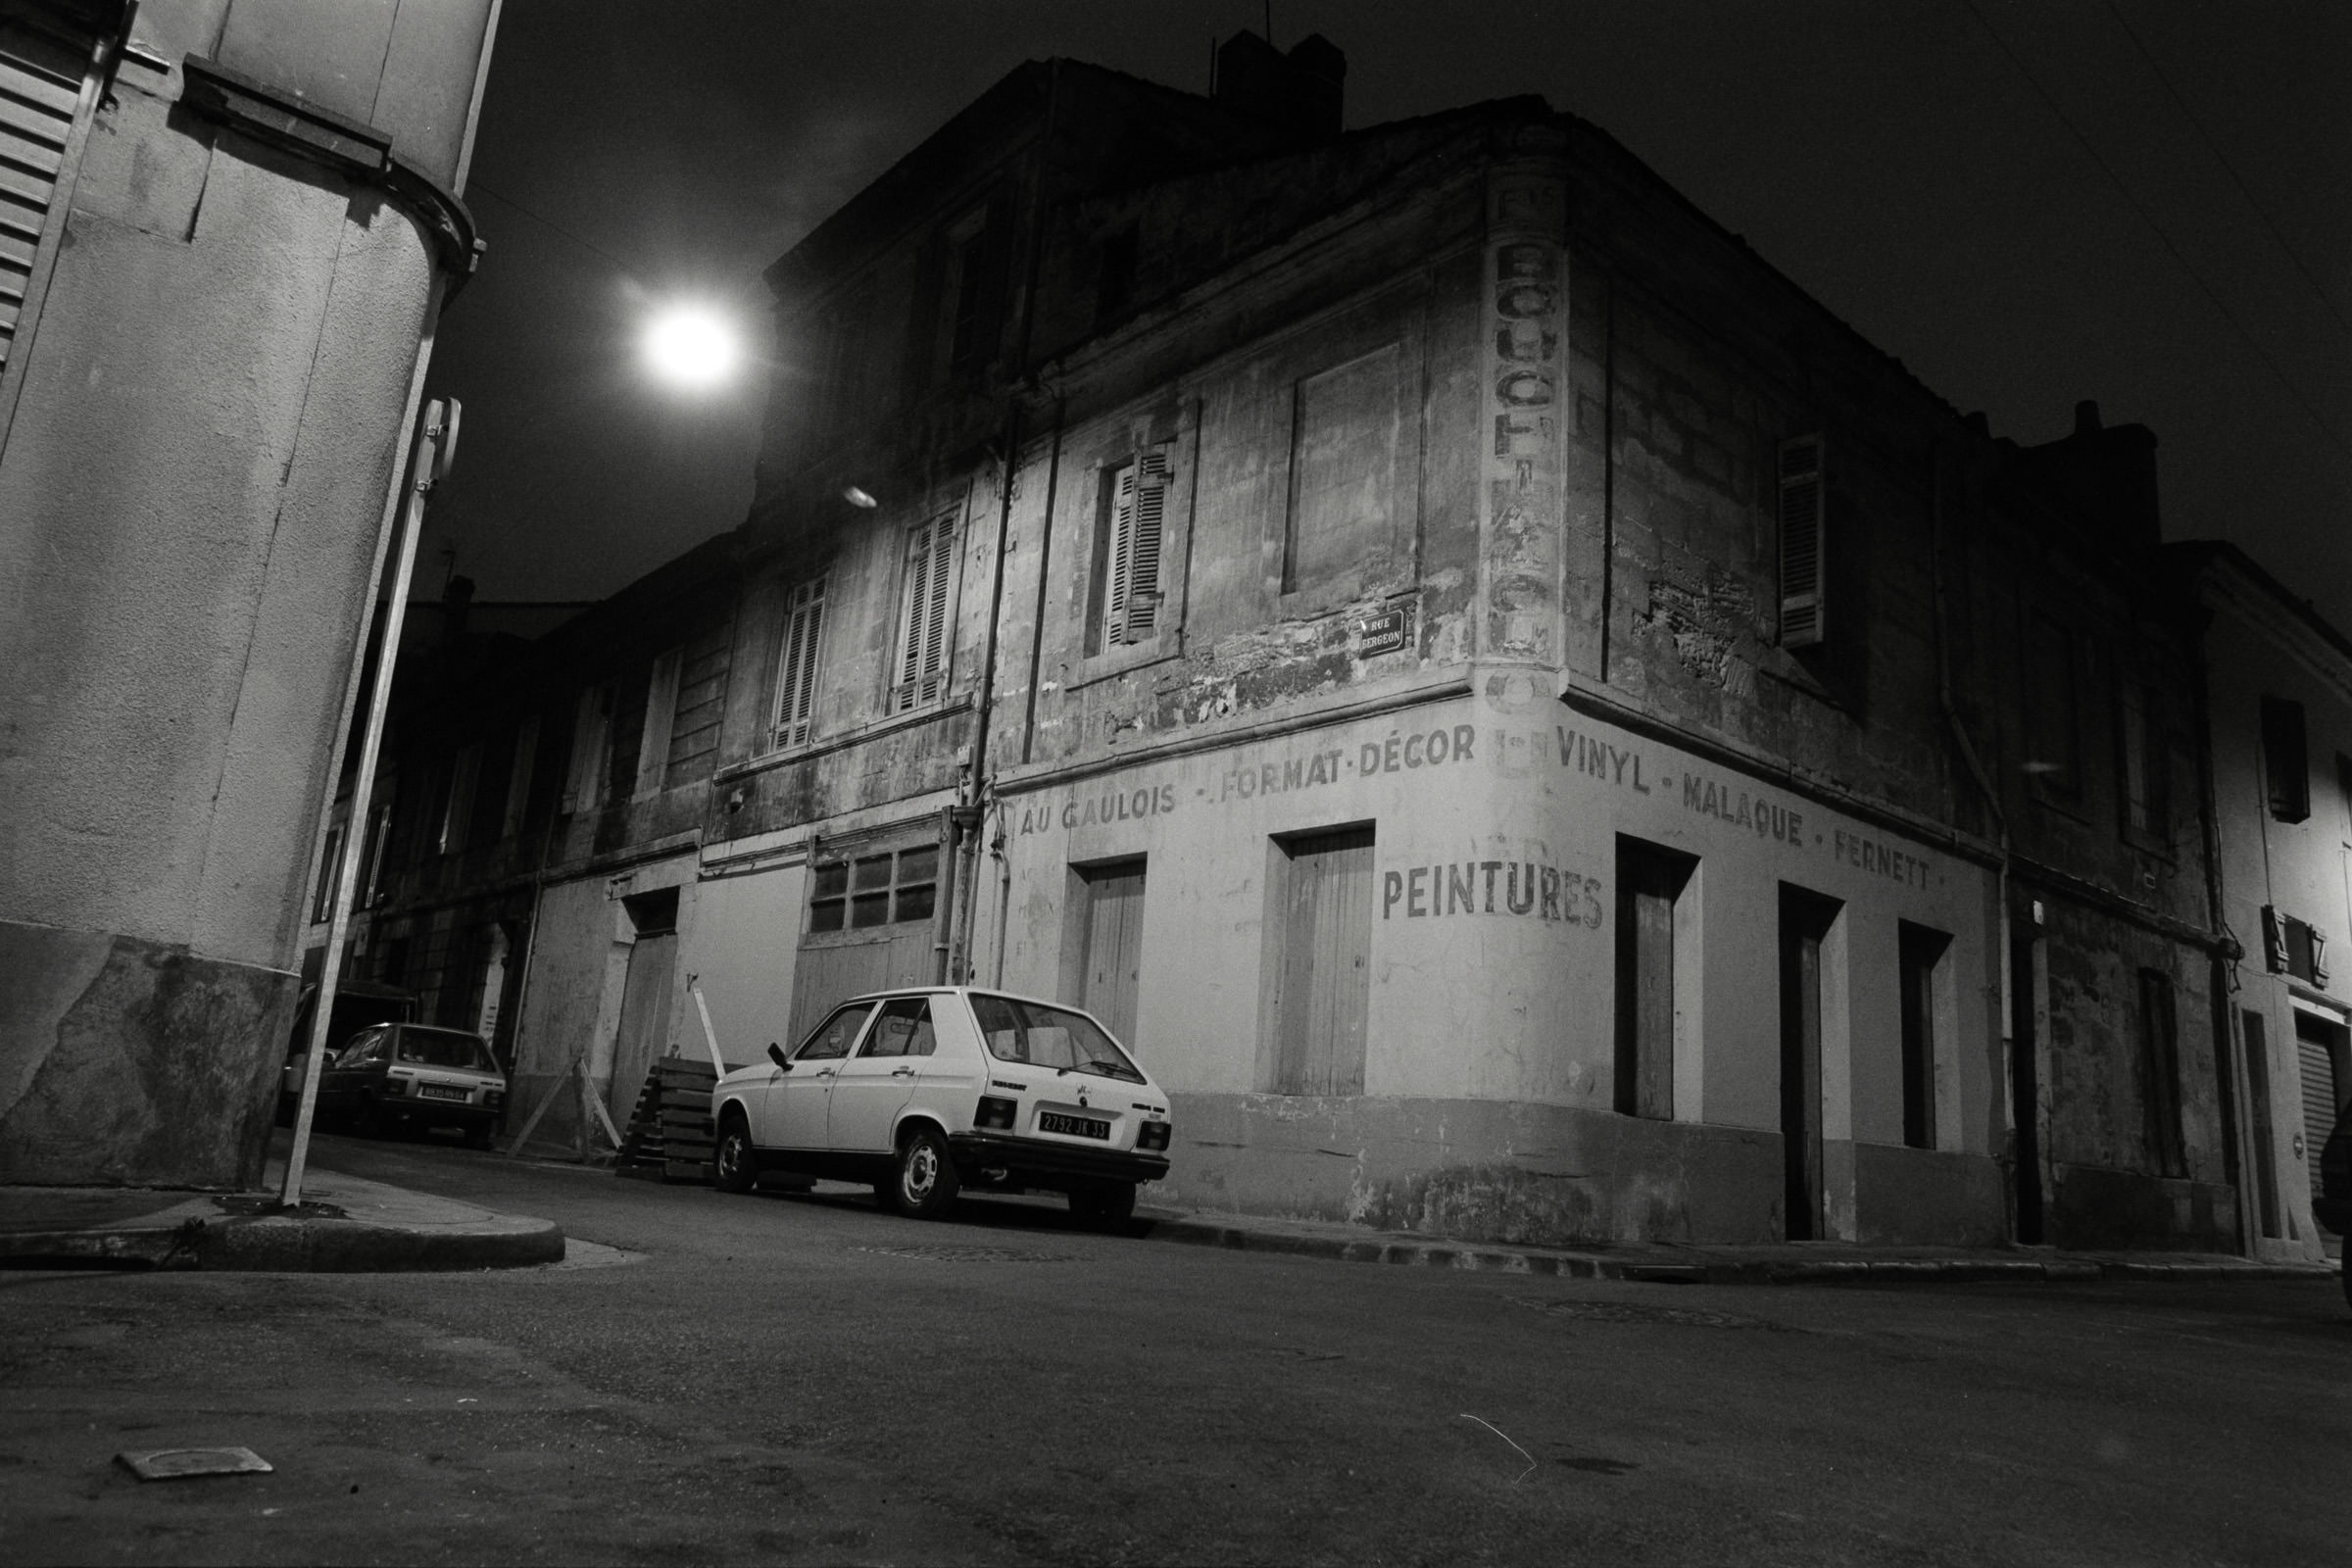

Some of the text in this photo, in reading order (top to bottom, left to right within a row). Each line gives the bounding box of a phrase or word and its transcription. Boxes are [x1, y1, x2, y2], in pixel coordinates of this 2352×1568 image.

[1371, 617, 1391, 632] RUE
[1020, 808, 1051, 836] AU
[1061, 784, 1176, 830] GAULOIS
[1221, 749, 1343, 802] FORMAT
[1359, 724, 1476, 777] DÉCOR
[1557, 725, 1930, 890] VINYL MALAQUE FERNETT
[1383, 860, 1602, 929] PEINTURES
[1045, 1115, 1073, 1132] 2792
[1093, 1121, 1105, 1138] 33
